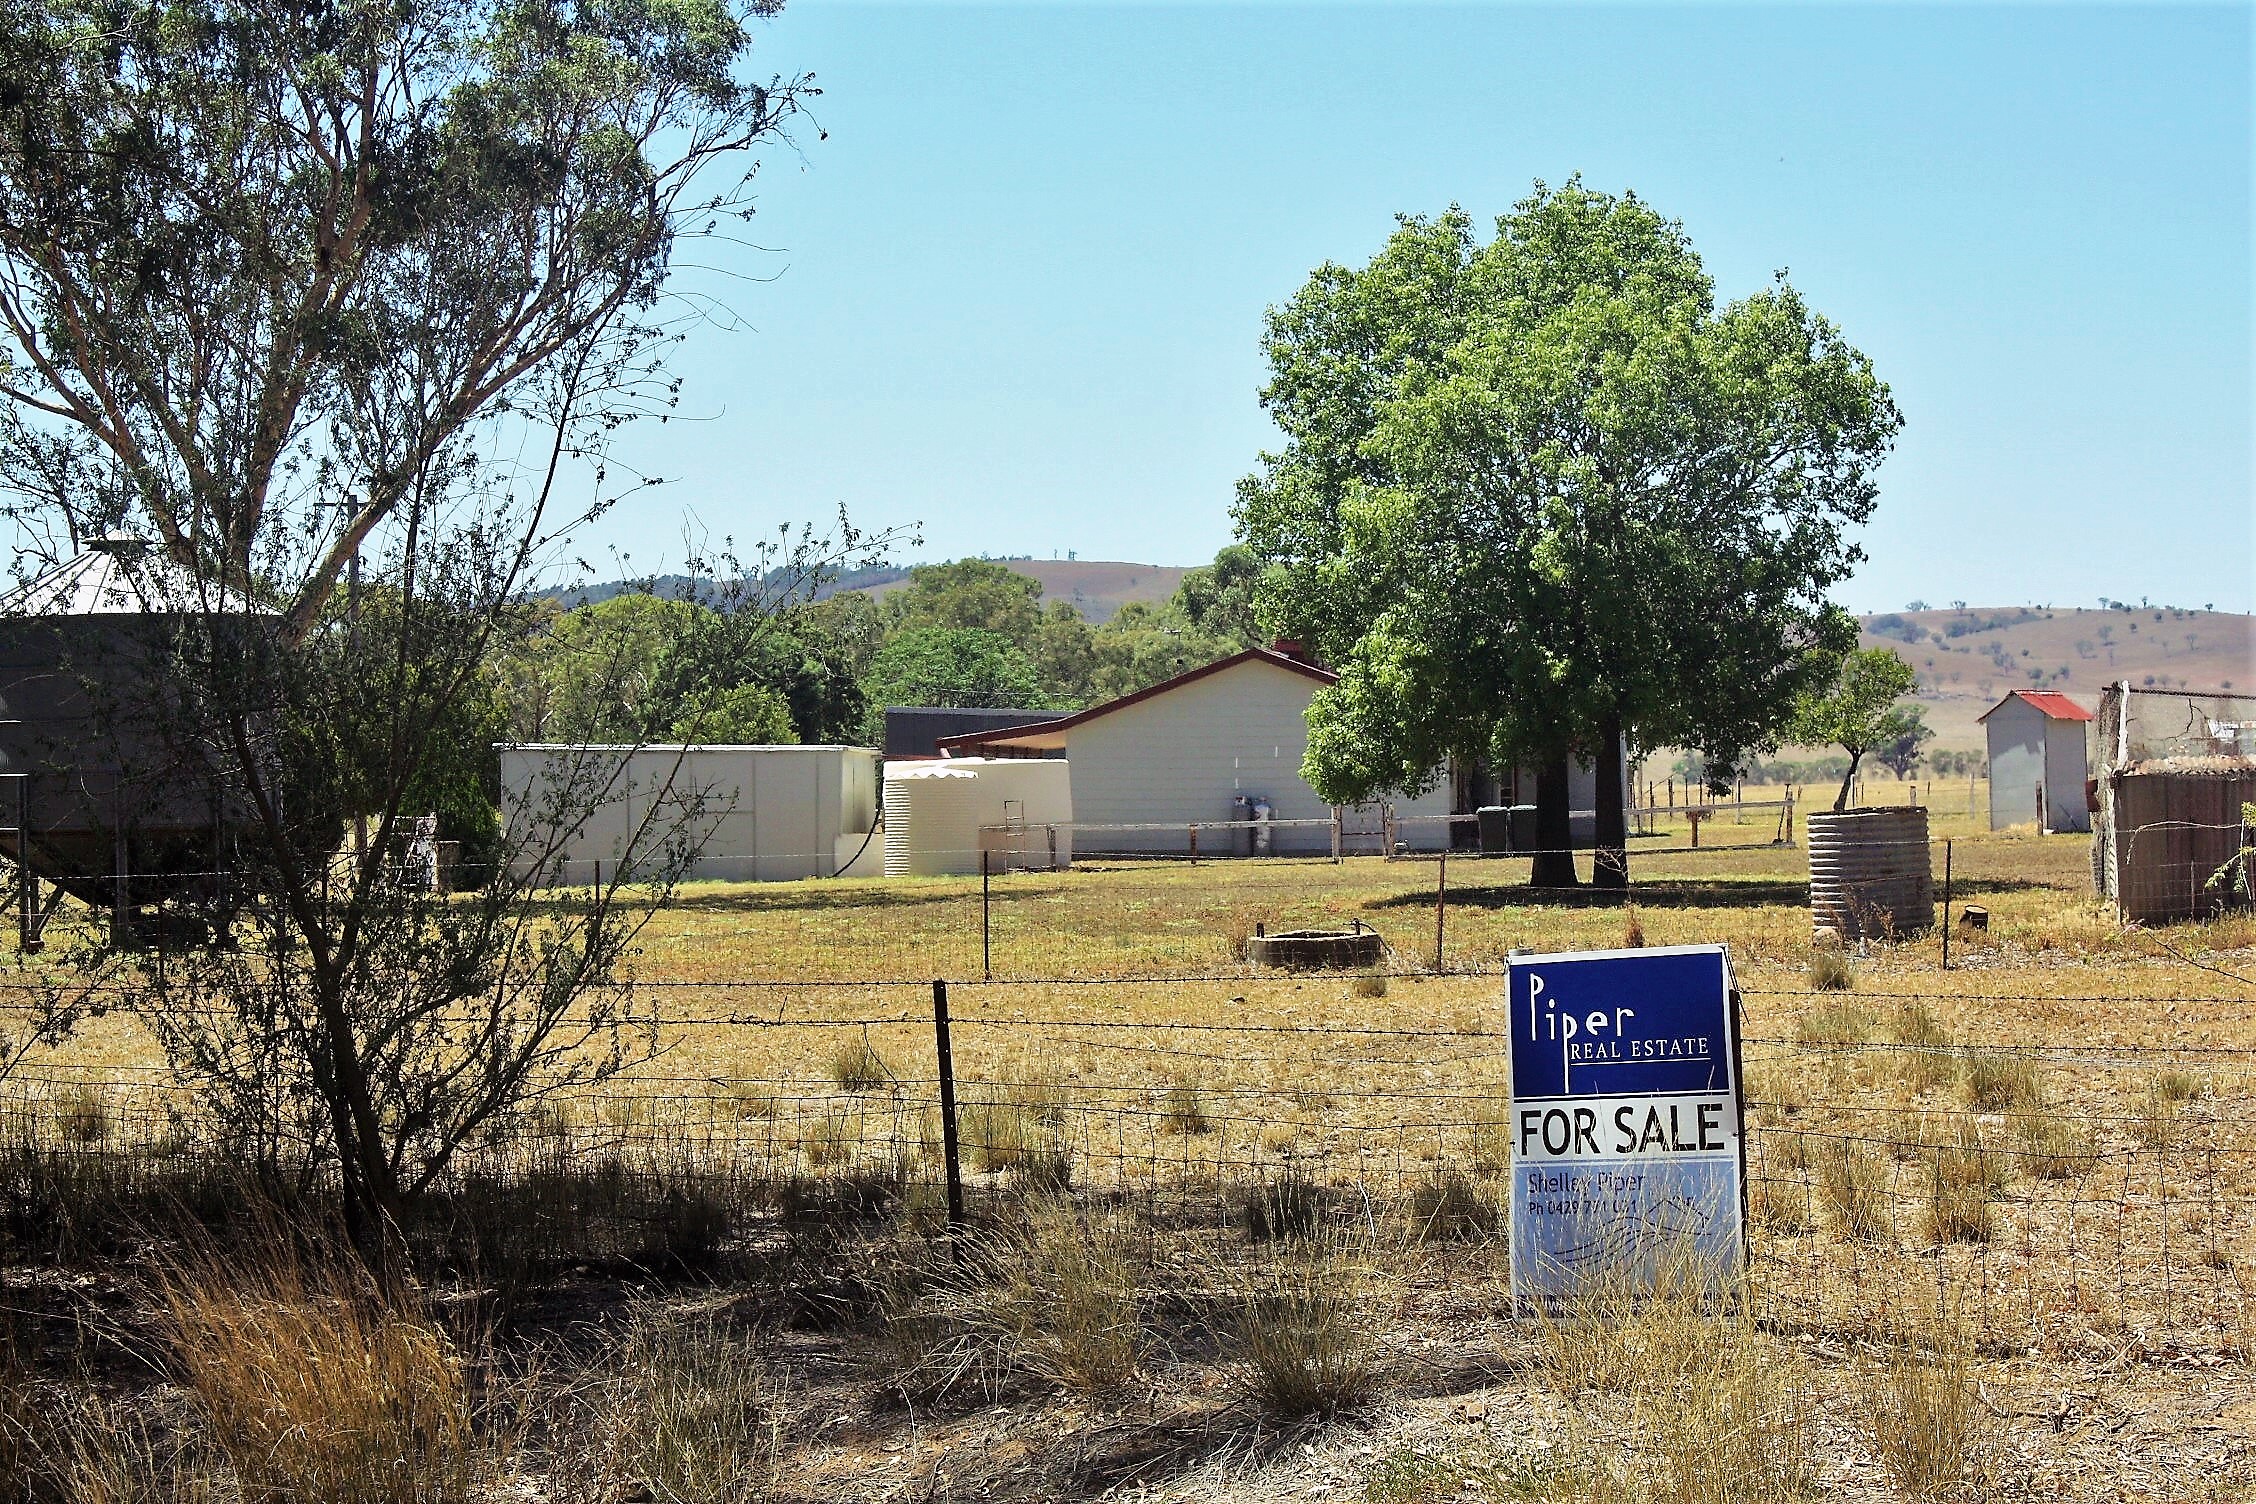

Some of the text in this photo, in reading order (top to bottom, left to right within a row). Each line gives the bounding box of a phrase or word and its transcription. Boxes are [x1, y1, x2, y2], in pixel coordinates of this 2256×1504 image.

[1530, 973, 1634, 1094] Piper
[1570, 1038, 1709, 1061] REAL ESTATE
[1520, 1103, 1725, 1156] FOR SALE
[1529, 1201, 1544, 1215] Ph
